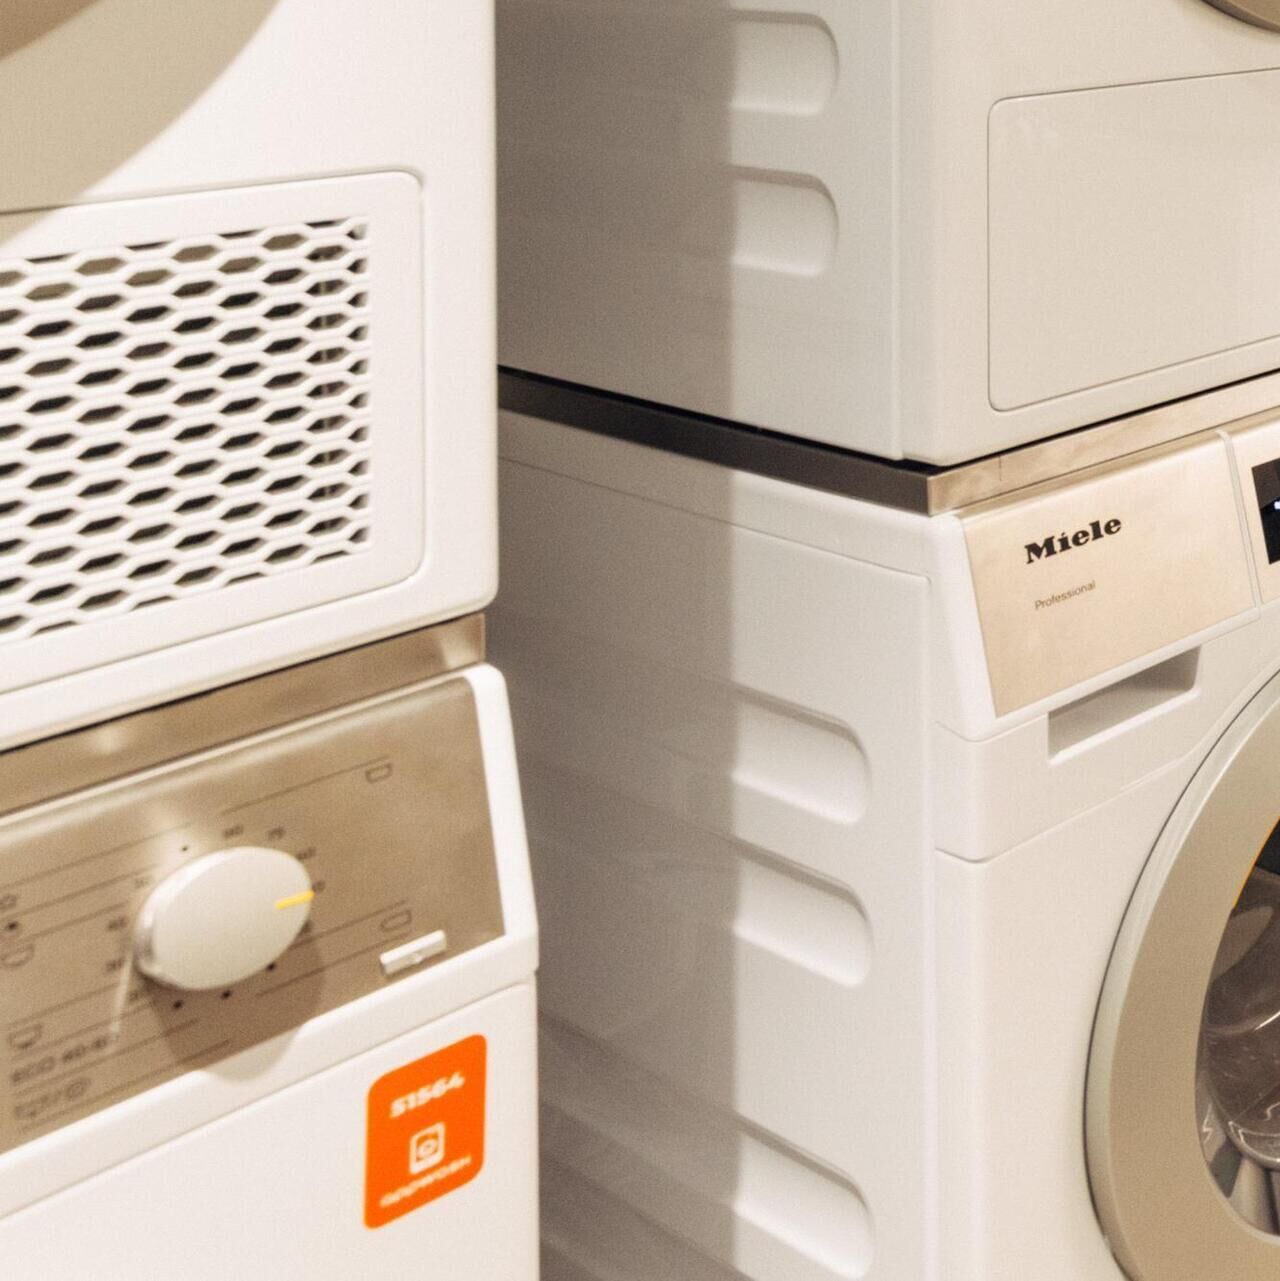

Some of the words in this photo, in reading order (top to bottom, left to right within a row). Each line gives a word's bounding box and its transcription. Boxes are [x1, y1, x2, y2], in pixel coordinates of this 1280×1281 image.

[1024, 518, 1122, 565] Miele
[1034, 580, 1097, 610] Professional
[389, 1072, 466, 1119] 51564
